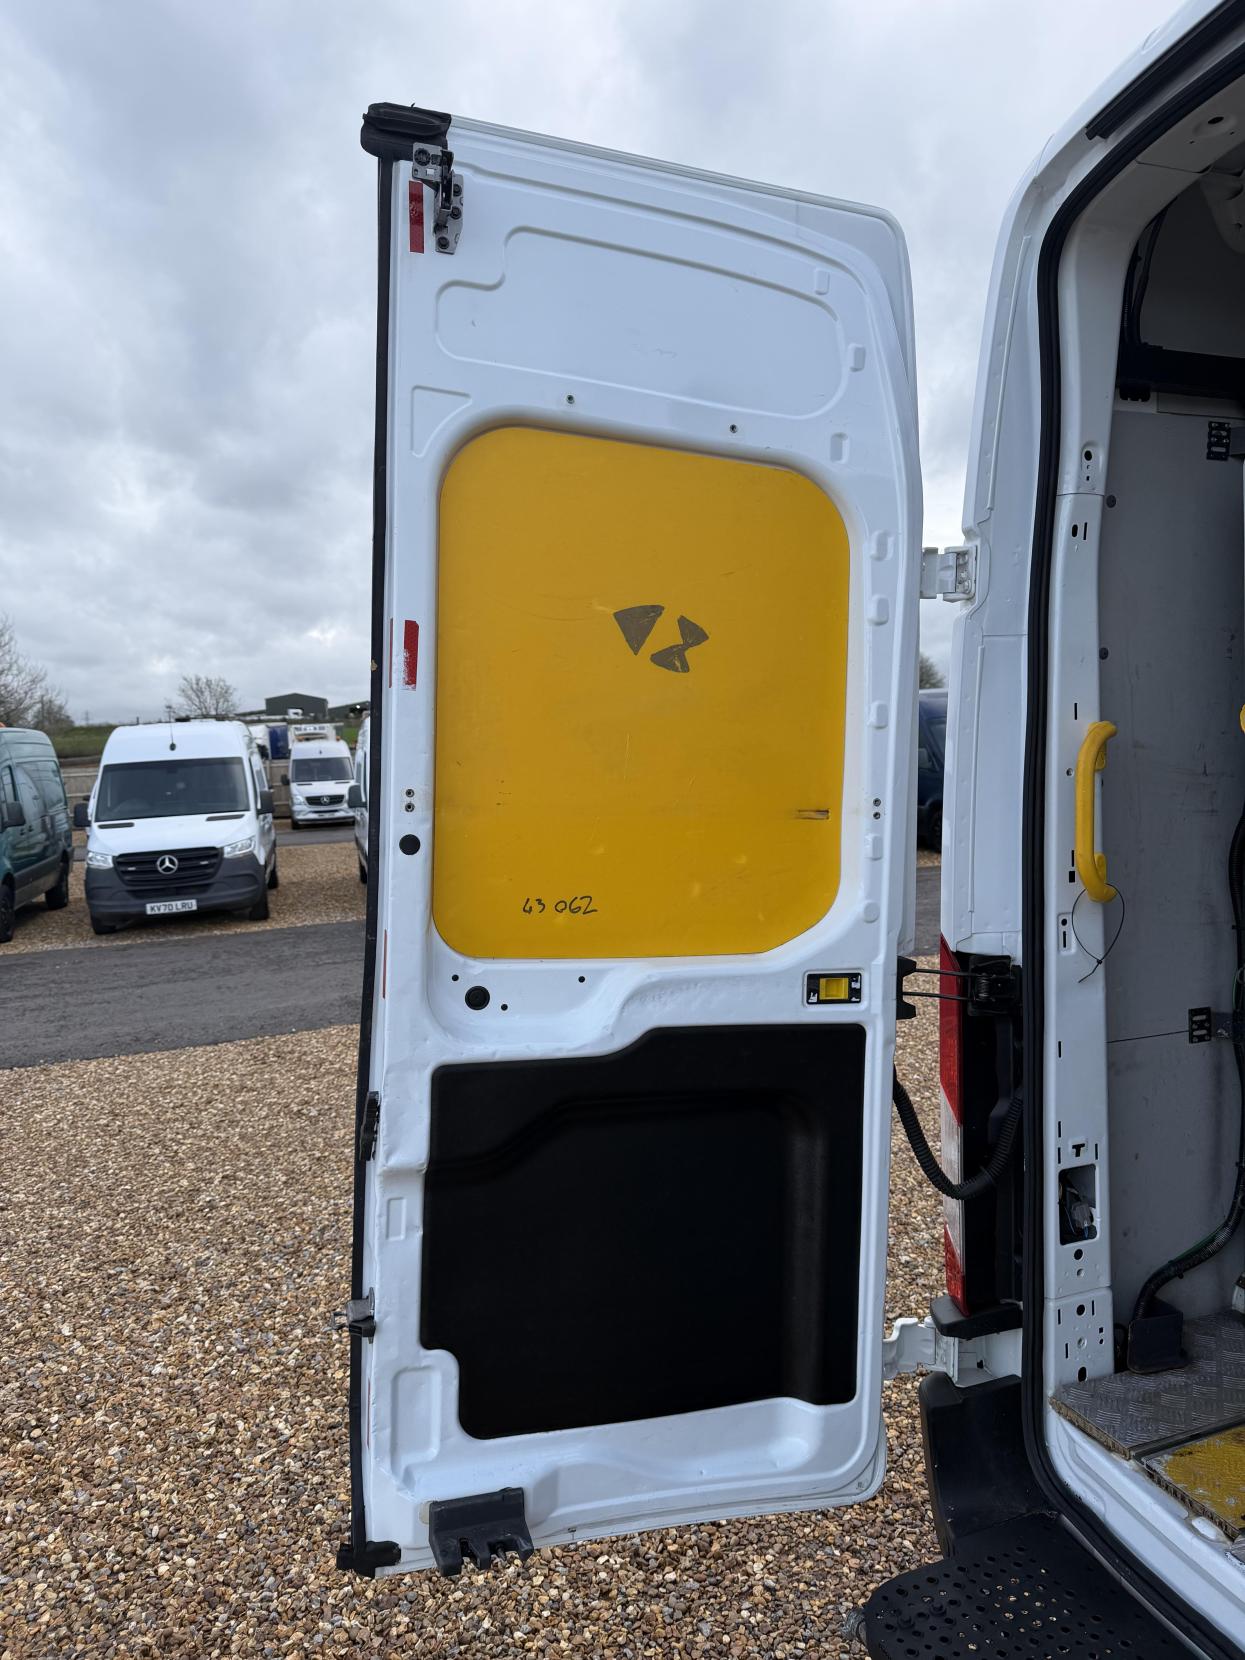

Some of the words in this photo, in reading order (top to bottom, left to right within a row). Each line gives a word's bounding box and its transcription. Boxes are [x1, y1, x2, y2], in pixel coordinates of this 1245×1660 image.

[150, 904, 174, 912] KV70
[175, 902, 193, 910] LRU
[522, 897, 546, 915] 43
[554, 895, 599, 915] 062
